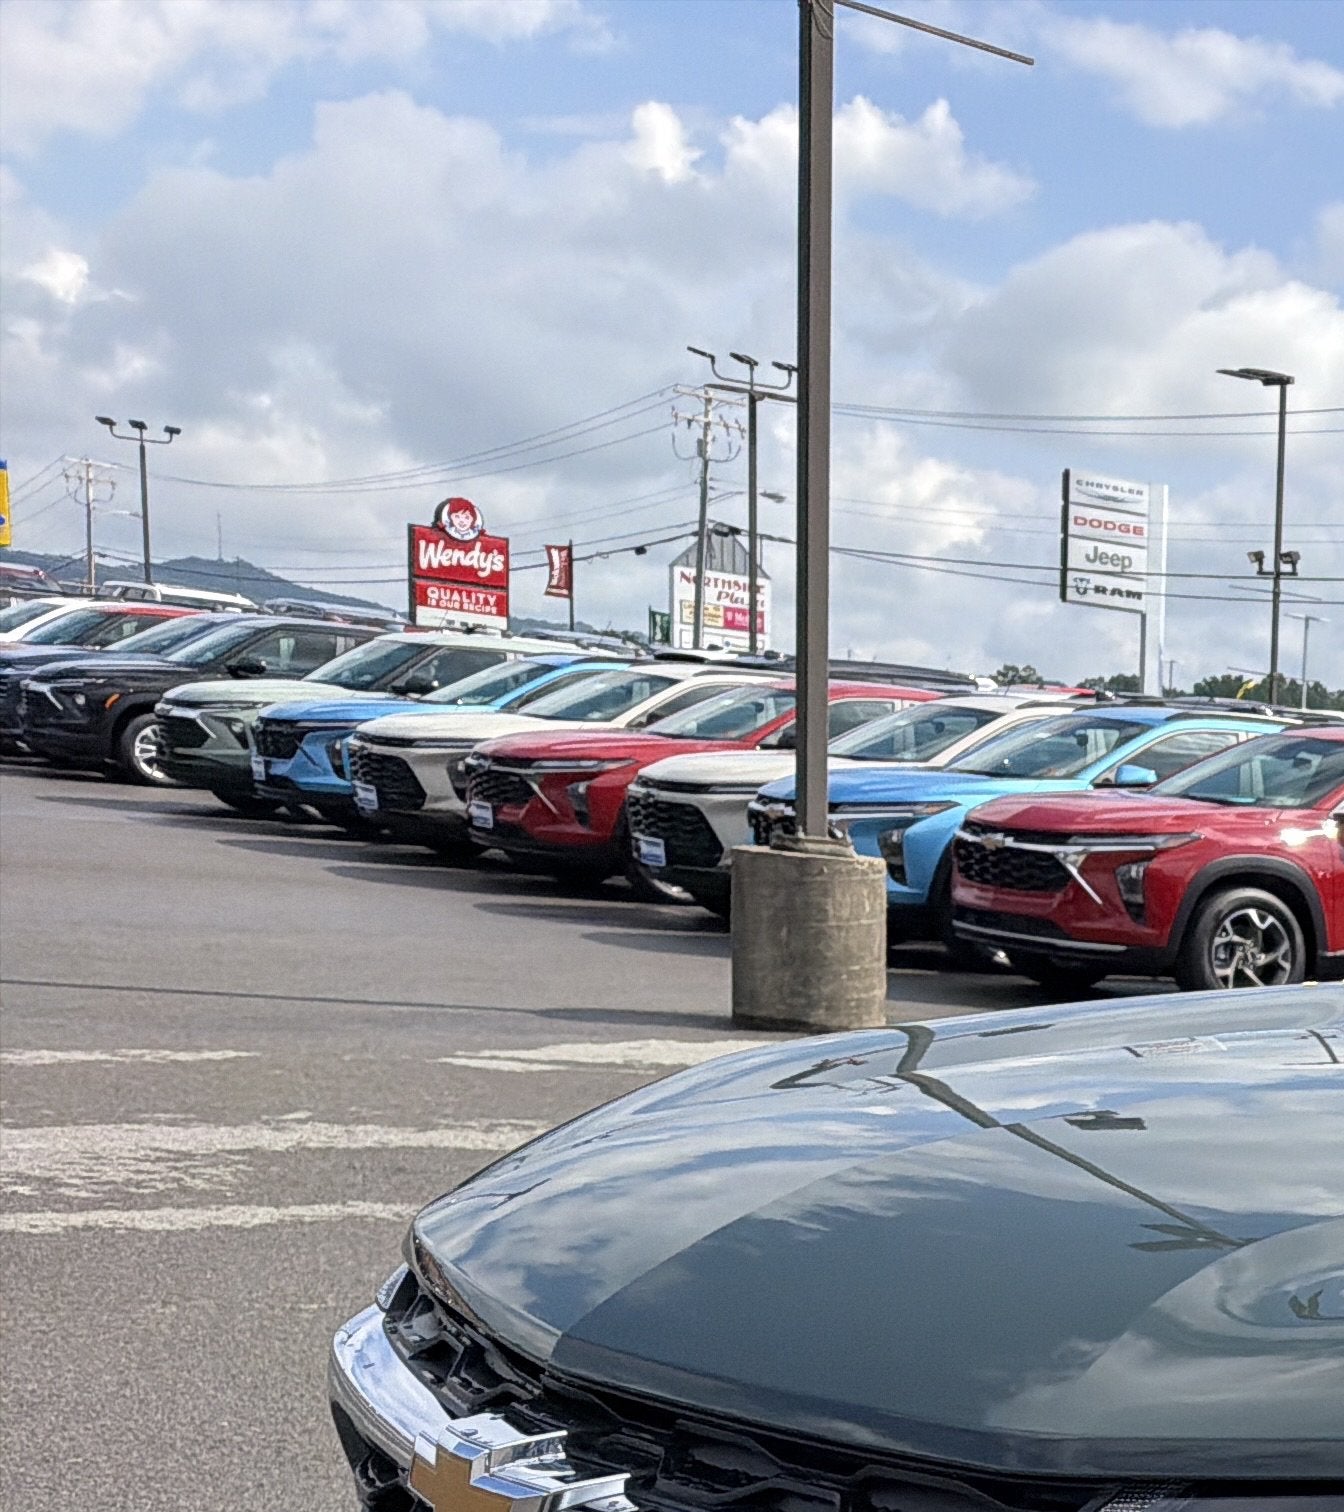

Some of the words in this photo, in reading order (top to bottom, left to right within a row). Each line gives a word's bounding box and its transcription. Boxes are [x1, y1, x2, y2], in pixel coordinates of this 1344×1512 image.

[1075, 479, 1144, 496] CHRYSLER
[1073, 515, 1145, 536] DODGE
[418, 539, 505, 578] Wendy's
[1084, 545, 1133, 573] Jeep
[680, 571, 765, 595] NRTHSIE
[1093, 585, 1143, 600] RAM
[426, 586, 497, 606] QUALITY
[716, 590, 765, 608] Plaa
